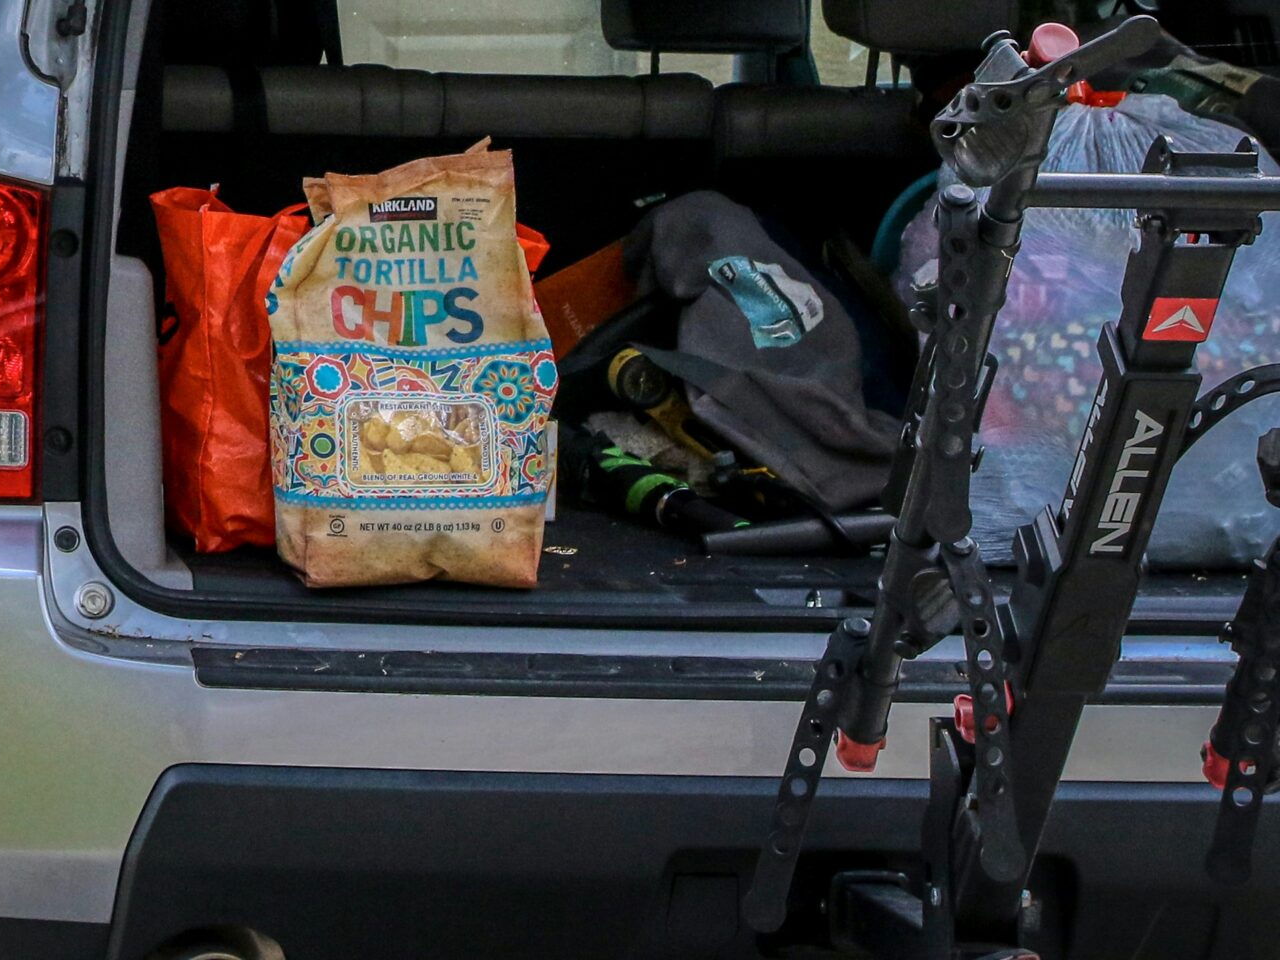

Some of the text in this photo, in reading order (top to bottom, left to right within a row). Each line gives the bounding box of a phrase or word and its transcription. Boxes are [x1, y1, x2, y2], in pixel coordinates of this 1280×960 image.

[372, 199, 435, 213] KIRKLAND
[335, 221, 476, 254] ORGANIC
[335, 256, 479, 285] TORTILLA
[331, 285, 484, 346] CHIPS
[379, 403, 429, 411] RESTAURANT
[1089, 409, 1164, 556] ALLEN
[359, 523, 375, 531] NET
[377, 523, 389, 531] WT
[392, 523, 402, 531] 40
[424, 523, 434, 531] LB
[443, 523, 454, 533] oz)
[456, 523, 470, 531] 1.13
[471, 523, 481, 532] kg
